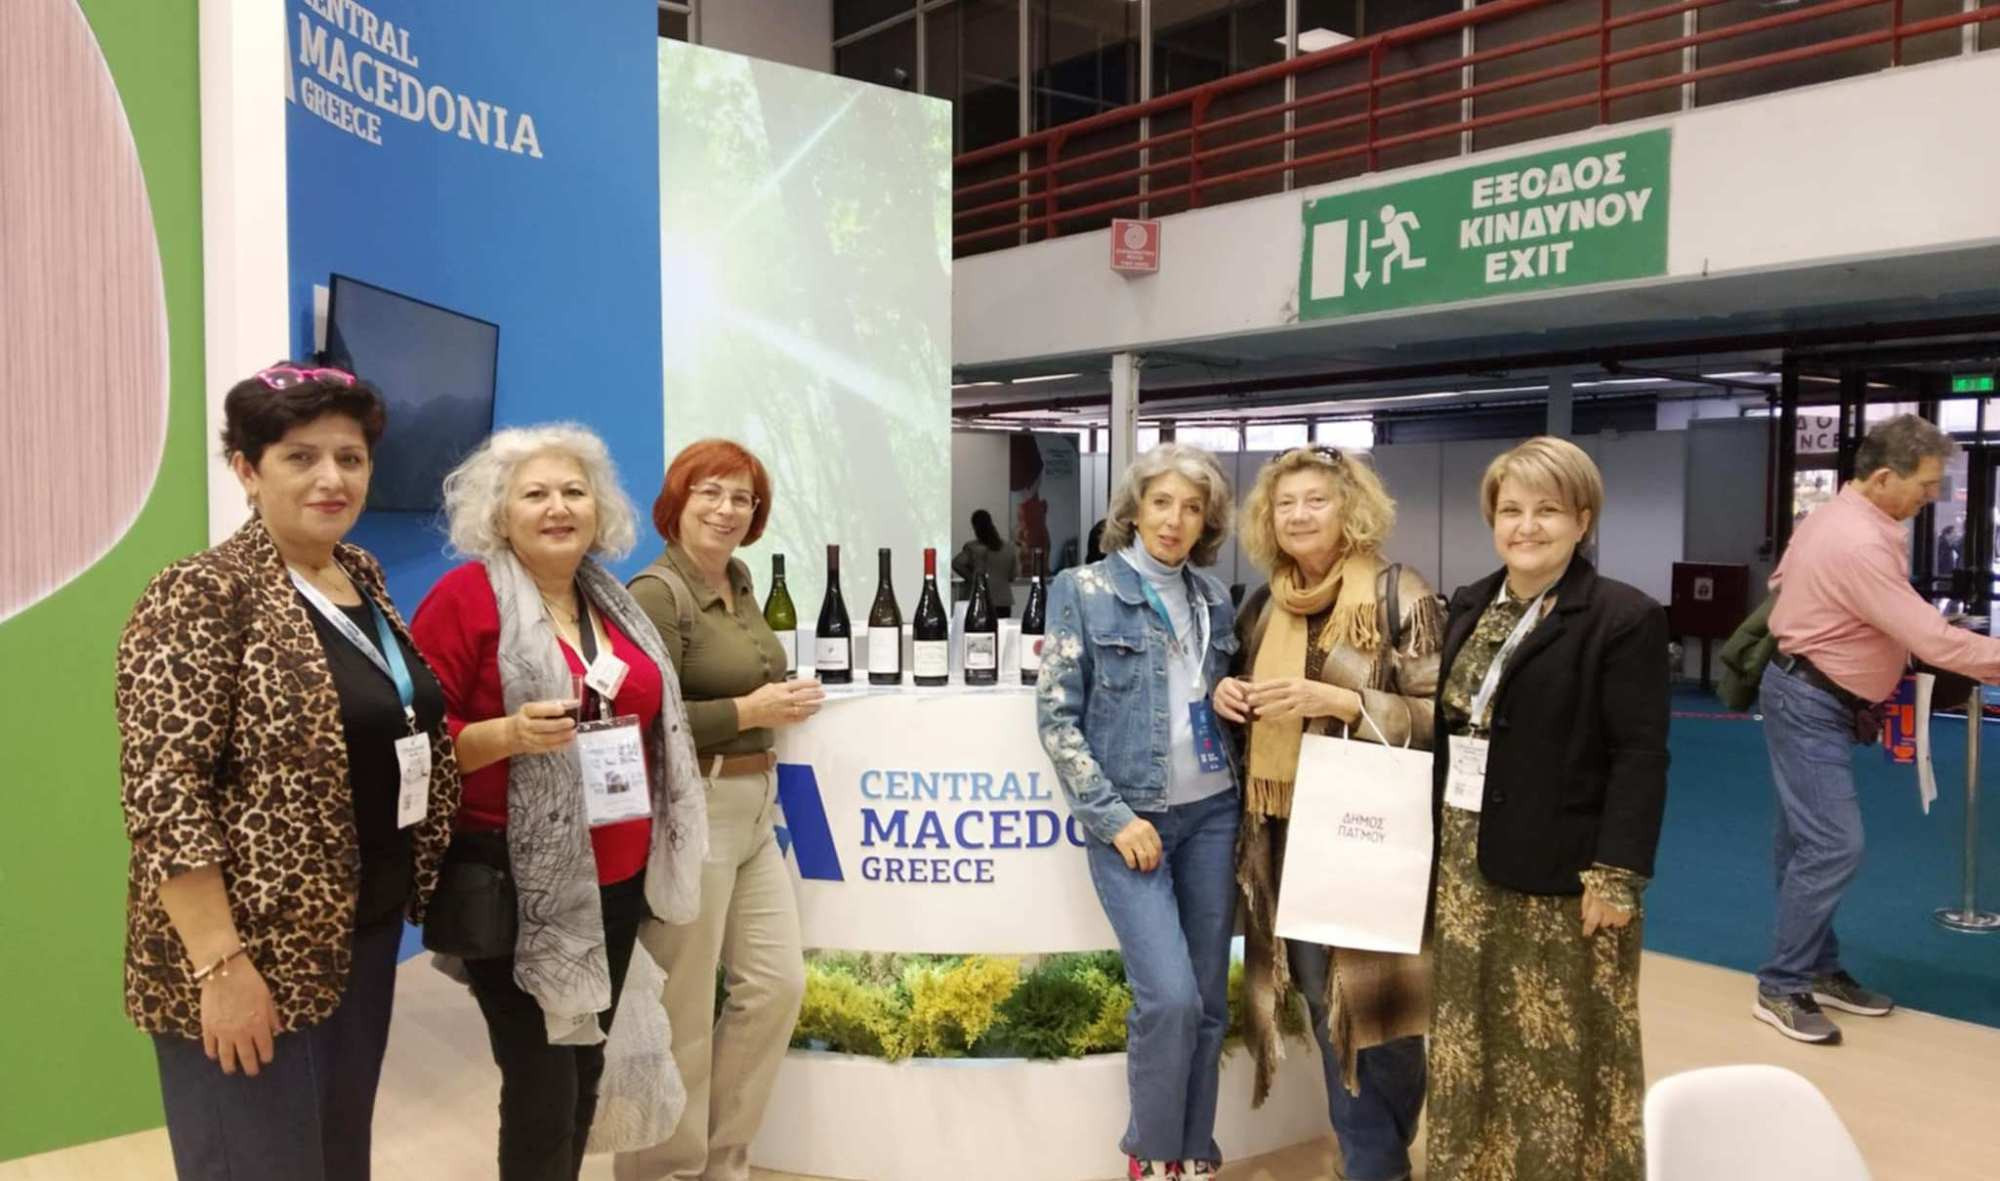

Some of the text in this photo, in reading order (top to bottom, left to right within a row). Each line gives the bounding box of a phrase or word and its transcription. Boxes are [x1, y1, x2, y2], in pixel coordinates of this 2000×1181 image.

[302, 0, 419, 68] NTRAL
[298, 11, 543, 158] MACEDONIA
[300, 76, 383, 146] GREECE
[1472, 151, 1627, 209] ΕΞΟΔΟΣ
[1459, 187, 1653, 249] ΚΙΝΔΥΝΟΥ
[1485, 241, 1574, 283] EXIT
[860, 770, 1052, 801] CENTRAL
[1337, 824, 1386, 844] ΠΑΤΜΟΥ
[1342, 811, 1384, 830] ΔΗΜΟΣ
[861, 856, 995, 883] GREECE
